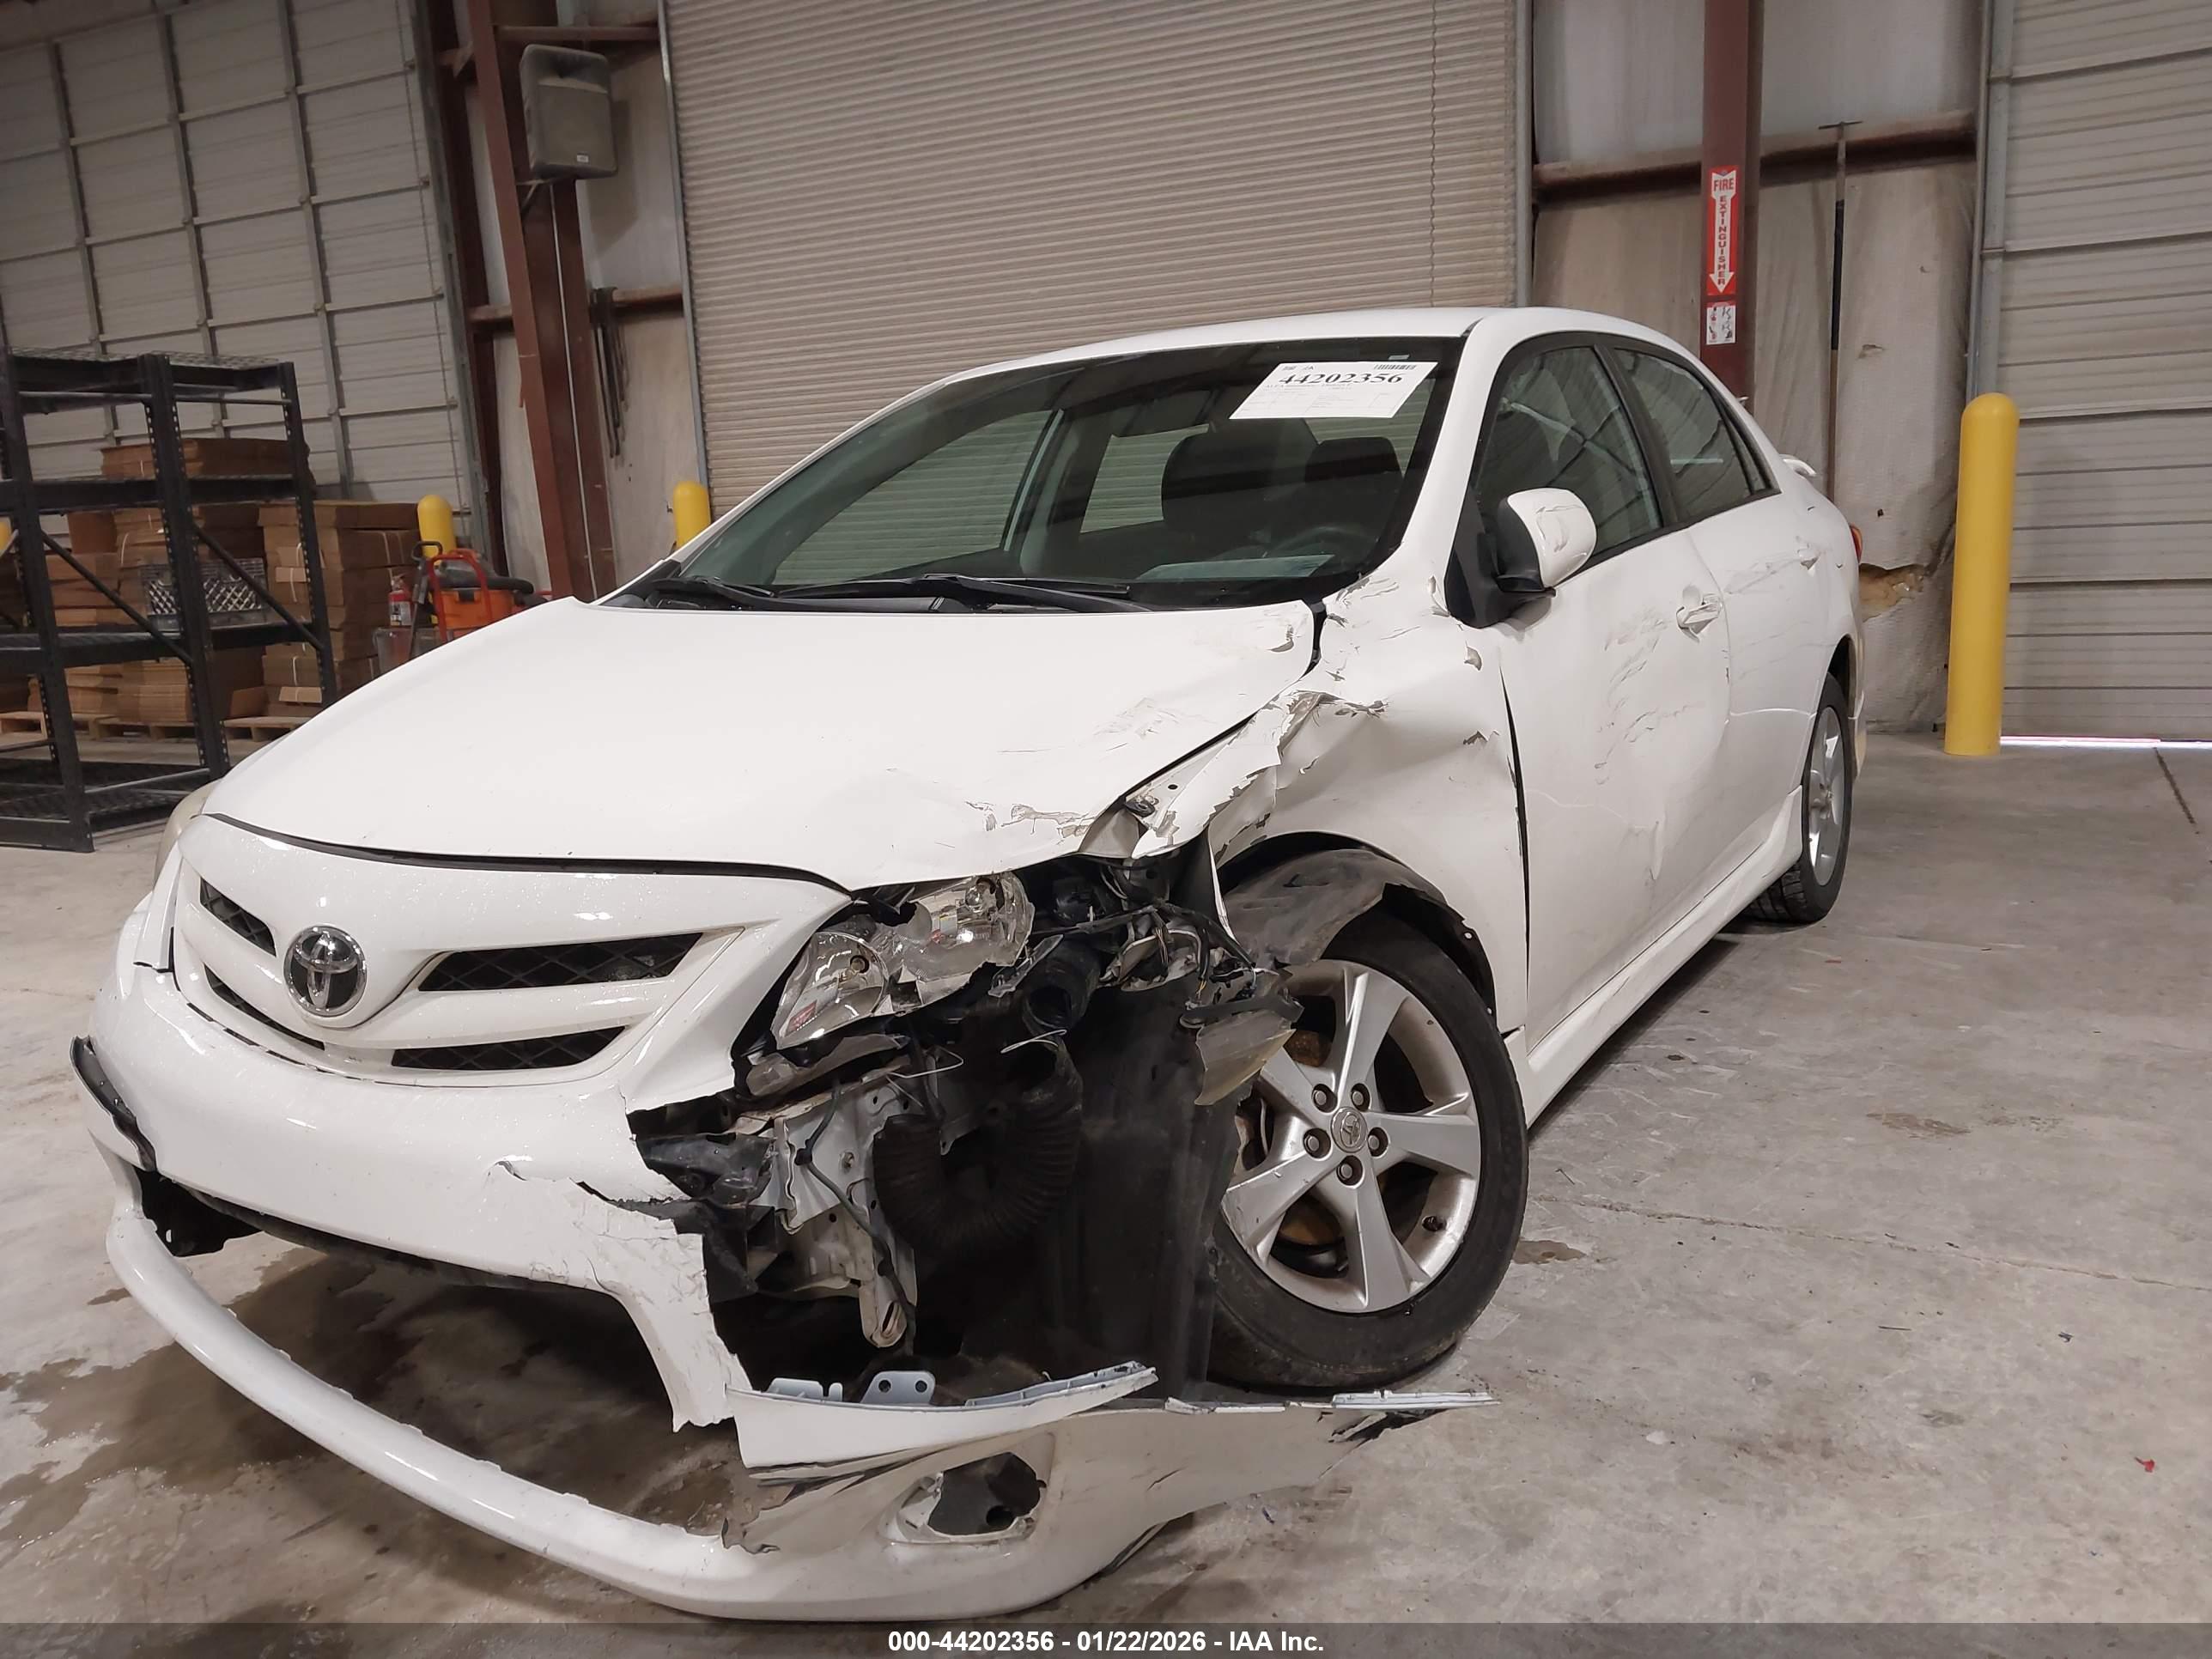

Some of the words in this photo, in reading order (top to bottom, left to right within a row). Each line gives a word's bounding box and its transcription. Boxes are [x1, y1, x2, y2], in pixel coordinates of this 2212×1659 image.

[1713, 178, 1735, 191] FIRE
[1717, 195, 1728, 285] EXTINGUISHER
[1279, 372, 1404, 384] 44202356
